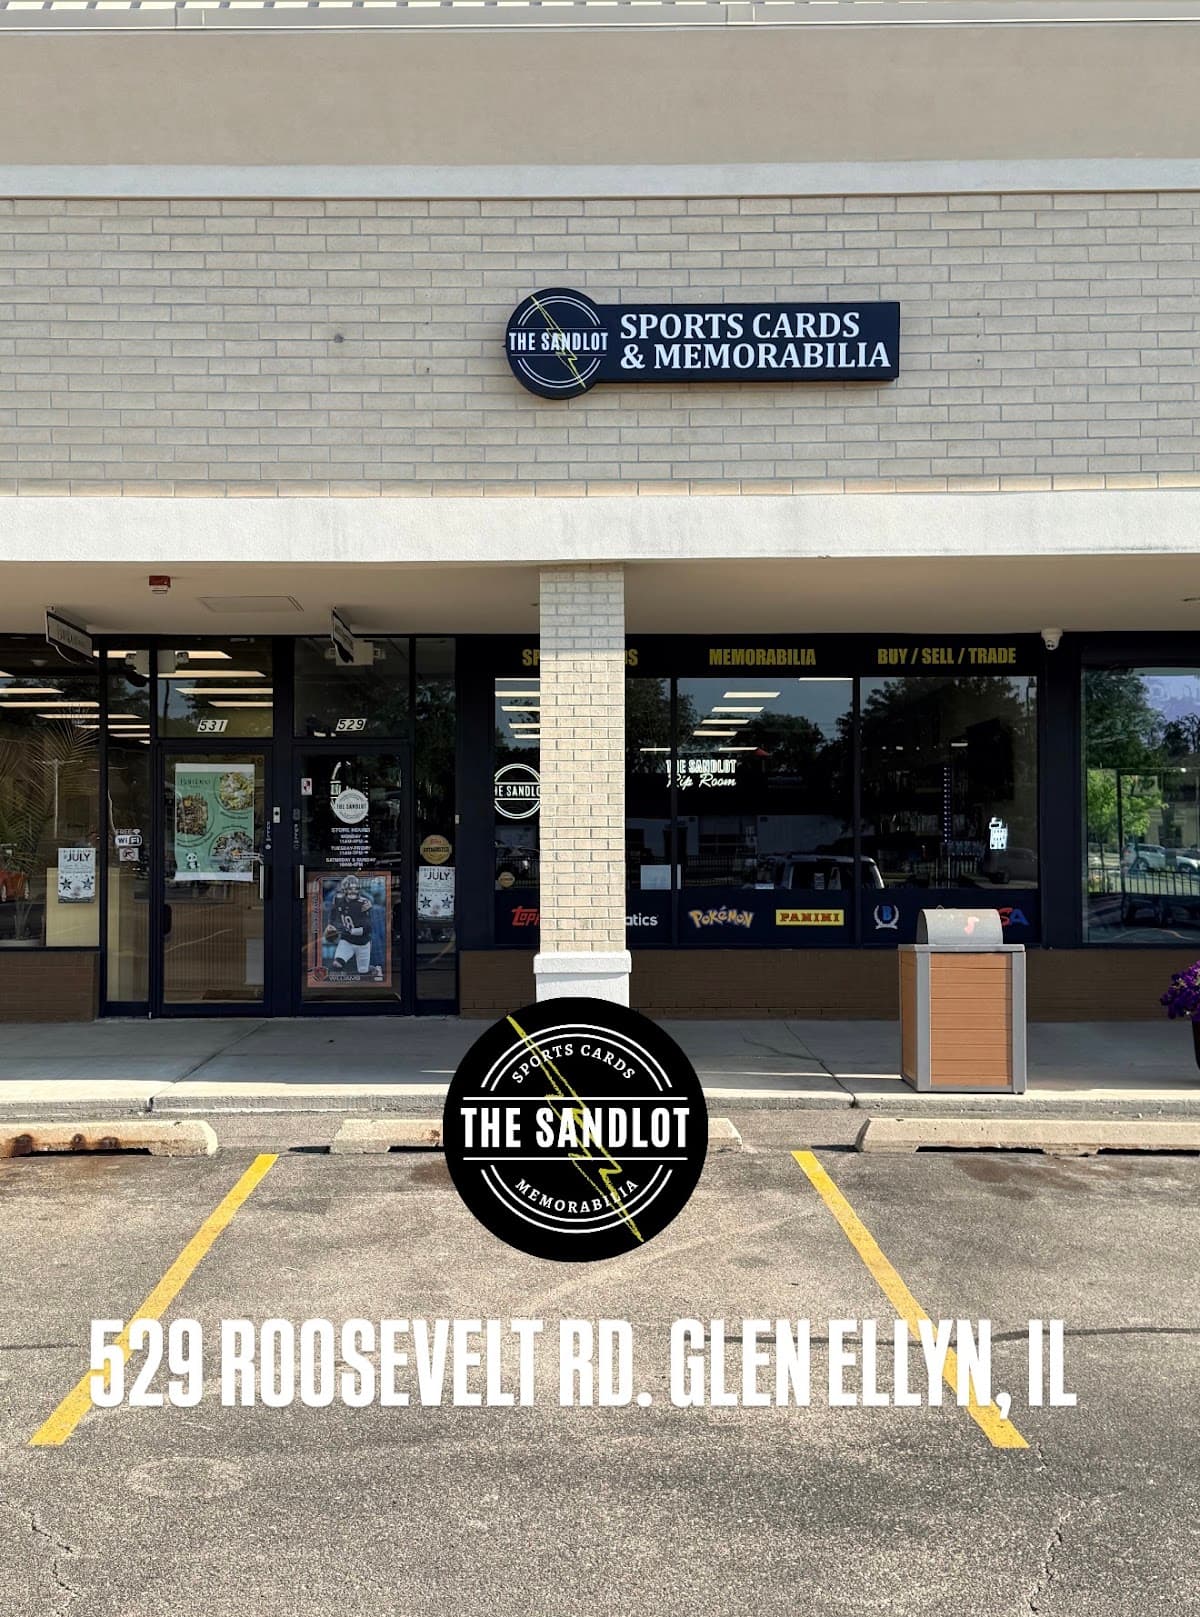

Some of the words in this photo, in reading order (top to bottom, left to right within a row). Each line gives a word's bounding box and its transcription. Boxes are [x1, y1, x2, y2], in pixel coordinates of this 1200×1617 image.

[620, 313, 745, 340] SPORTS
[752, 312, 861, 340] CARDS
[509, 332, 536, 352] THE
[541, 331, 609, 352] SANDLOT
[620, 343, 647, 370] &
[654, 342, 892, 370] MEMORABILIA
[709, 648, 818, 666] MEMORABILIA
[878, 648, 909, 665] BUY
[921, 648, 956, 665] SELL
[968, 647, 1017, 665] TRADE
[199, 720, 226, 732] 531
[337, 719, 365, 730] 529
[688, 759, 737, 774] SANDLOT
[698, 772, 737, 788] Room
[506, 785, 541, 797] SANDLO
[66, 852, 91, 863] JULY
[426, 871, 451, 881] JULY
[625, 912, 659, 927] atics
[779, 912, 841, 922] PANINI
[998, 907, 1030, 927] SA
